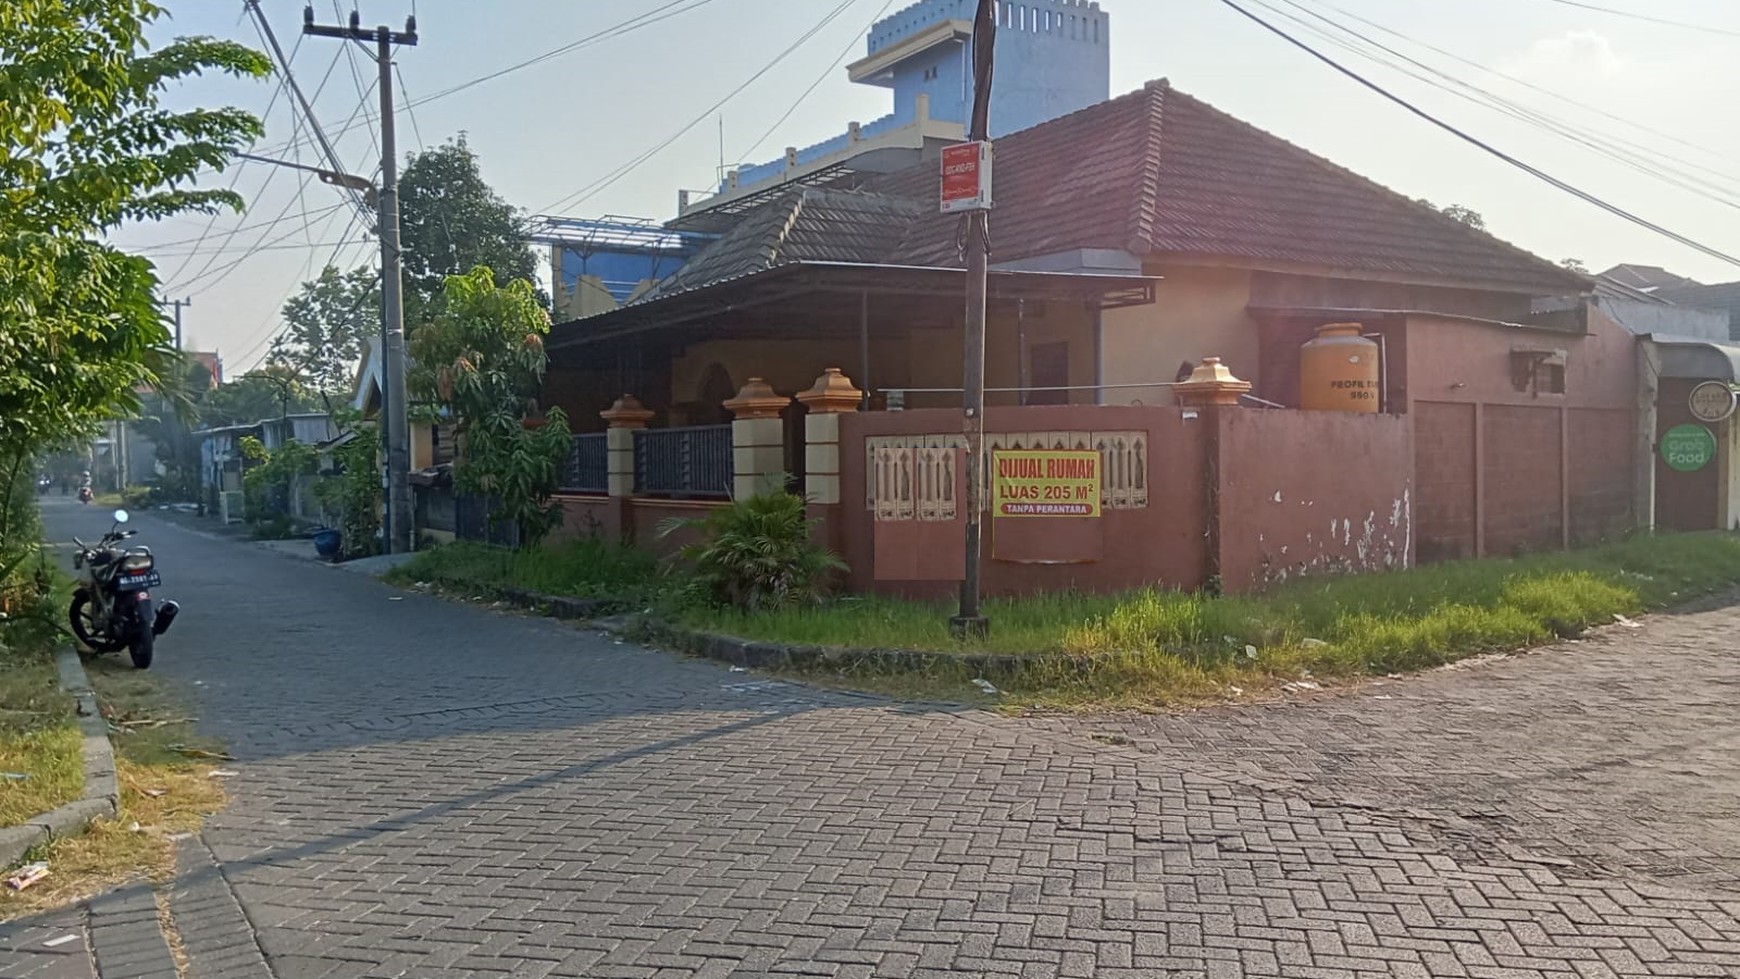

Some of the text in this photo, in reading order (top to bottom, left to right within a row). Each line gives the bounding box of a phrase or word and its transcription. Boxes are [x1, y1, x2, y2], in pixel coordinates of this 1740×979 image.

[1669, 439, 1705, 452] Grab
[1669, 452, 1705, 464] Food
[999, 458, 1095, 479] DIJUAL RUMAH
[1000, 485, 1039, 499] LUAS
[1044, 485, 1071, 499] 205
[1006, 504, 1087, 514] TANPA PERANTARA
